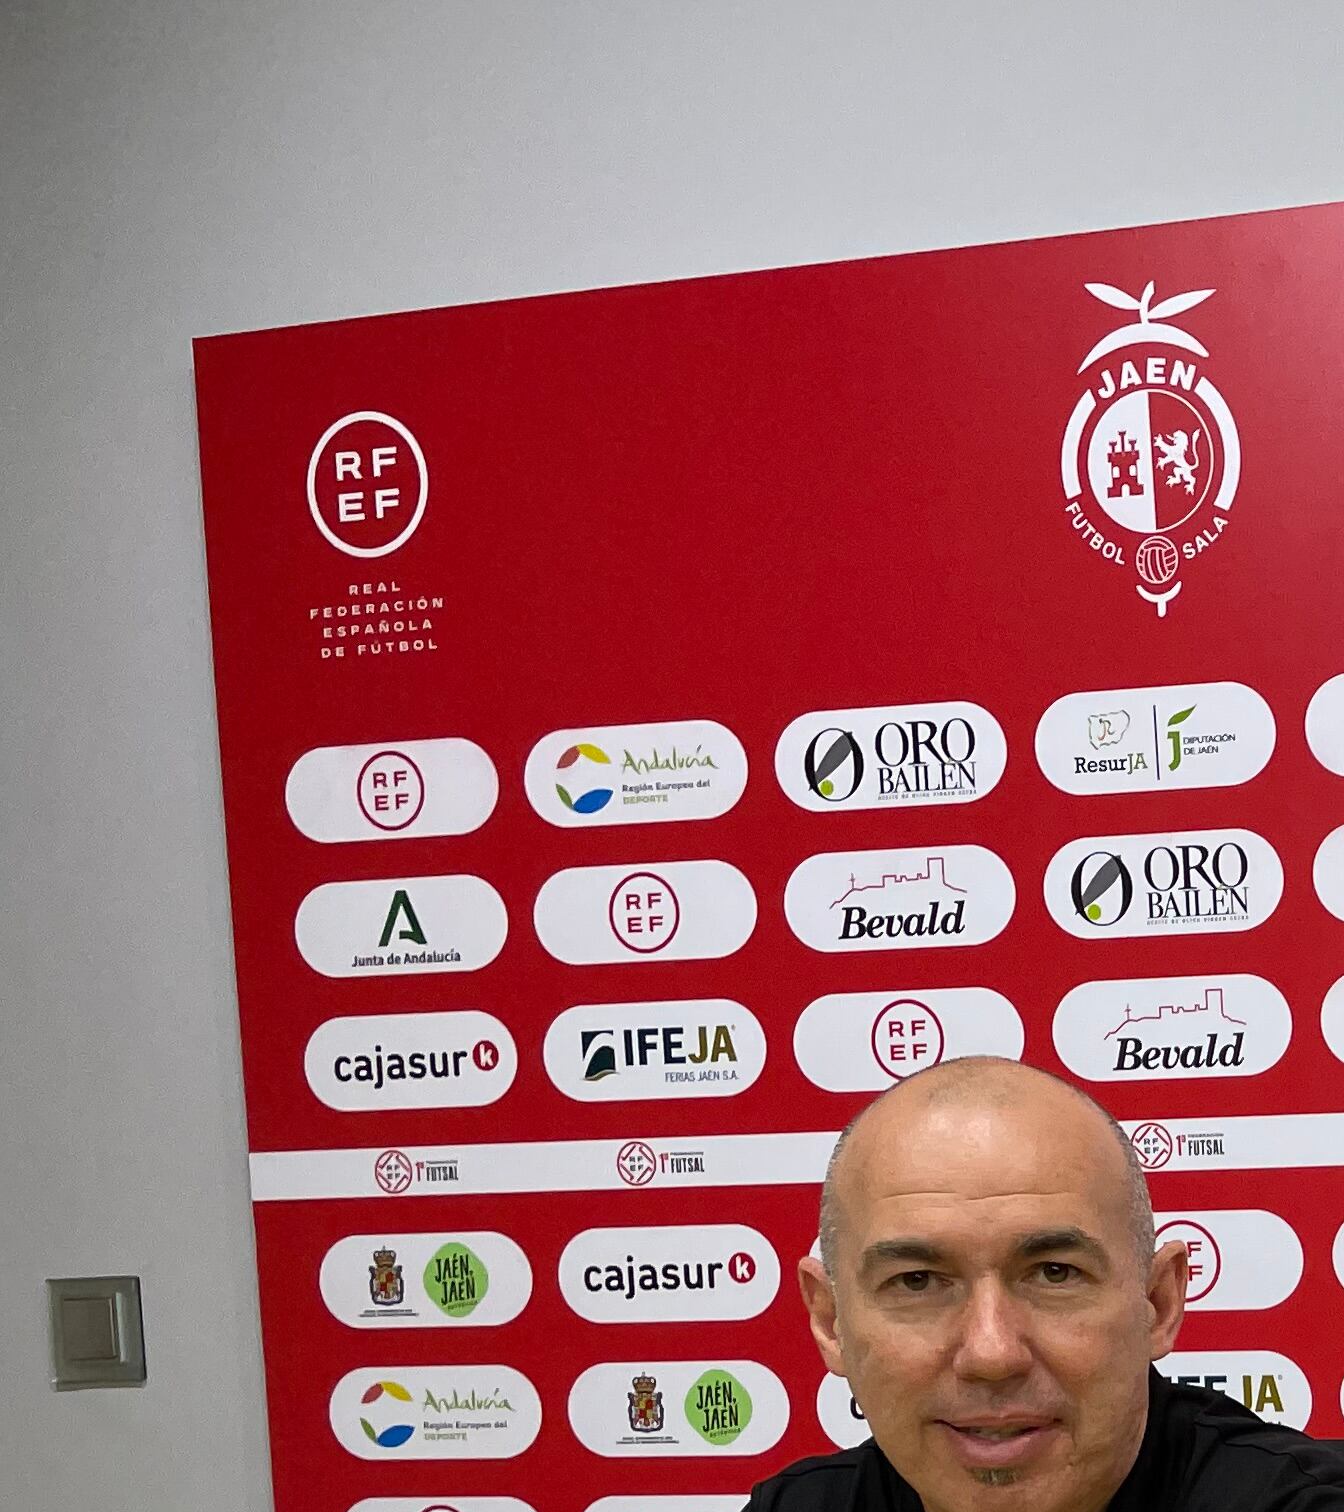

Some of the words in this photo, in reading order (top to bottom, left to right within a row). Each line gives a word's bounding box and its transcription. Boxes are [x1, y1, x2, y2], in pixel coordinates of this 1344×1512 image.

[1098, 358, 1196, 399] JAEN
[1066, 502, 1125, 564] FUTBOL
[1183, 517, 1228, 559] SALA
[349, 581, 400, 595] REAL
[310, 596, 443, 619] FEDERACIÓN
[324, 619, 432, 638] ESPAÑOLA
[321, 647, 344, 658] DE
[358, 639, 437, 655] FÚTBOL
[875, 718, 975, 766] ORO
[623, 745, 718, 775] Andalucía
[878, 759, 975, 794] BAILÉN
[1074, 753, 1147, 774] ResurJA
[1145, 843, 1247, 890] ORO
[1148, 884, 1247, 919] BAILÉN
[838, 900, 965, 939] Bevald
[352, 956, 384, 967] Junta
[387, 953, 401, 965] de
[404, 949, 460, 964] Andalucía
[624, 1026, 737, 1066] IFEJA
[1113, 1032, 1244, 1070] Bevald
[424, 1388, 515, 1413] Andalucía
